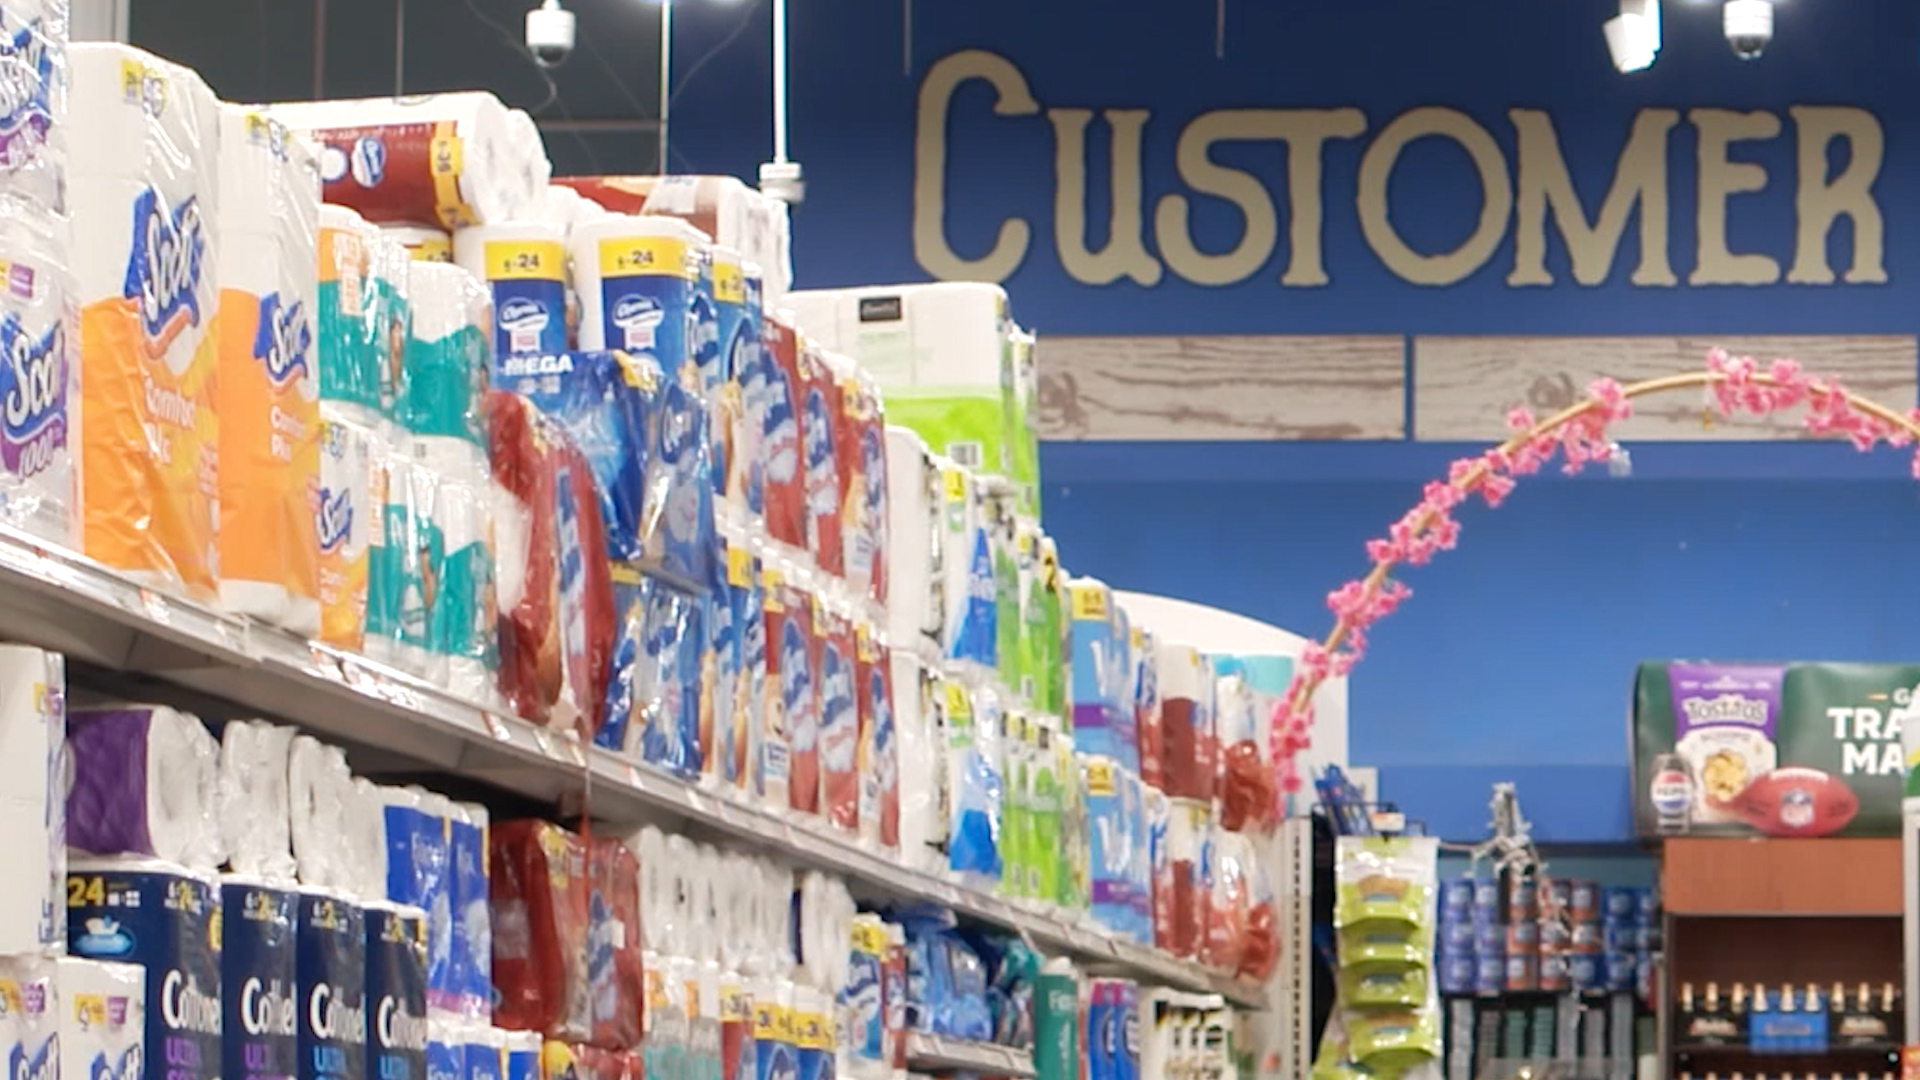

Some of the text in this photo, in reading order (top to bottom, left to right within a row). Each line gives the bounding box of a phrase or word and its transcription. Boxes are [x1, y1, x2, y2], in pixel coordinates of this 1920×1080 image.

[913, 50, 1888, 286] CUSTOMER
[504, 354, 574, 375] MEGA
[67, 876, 106, 908] 24
